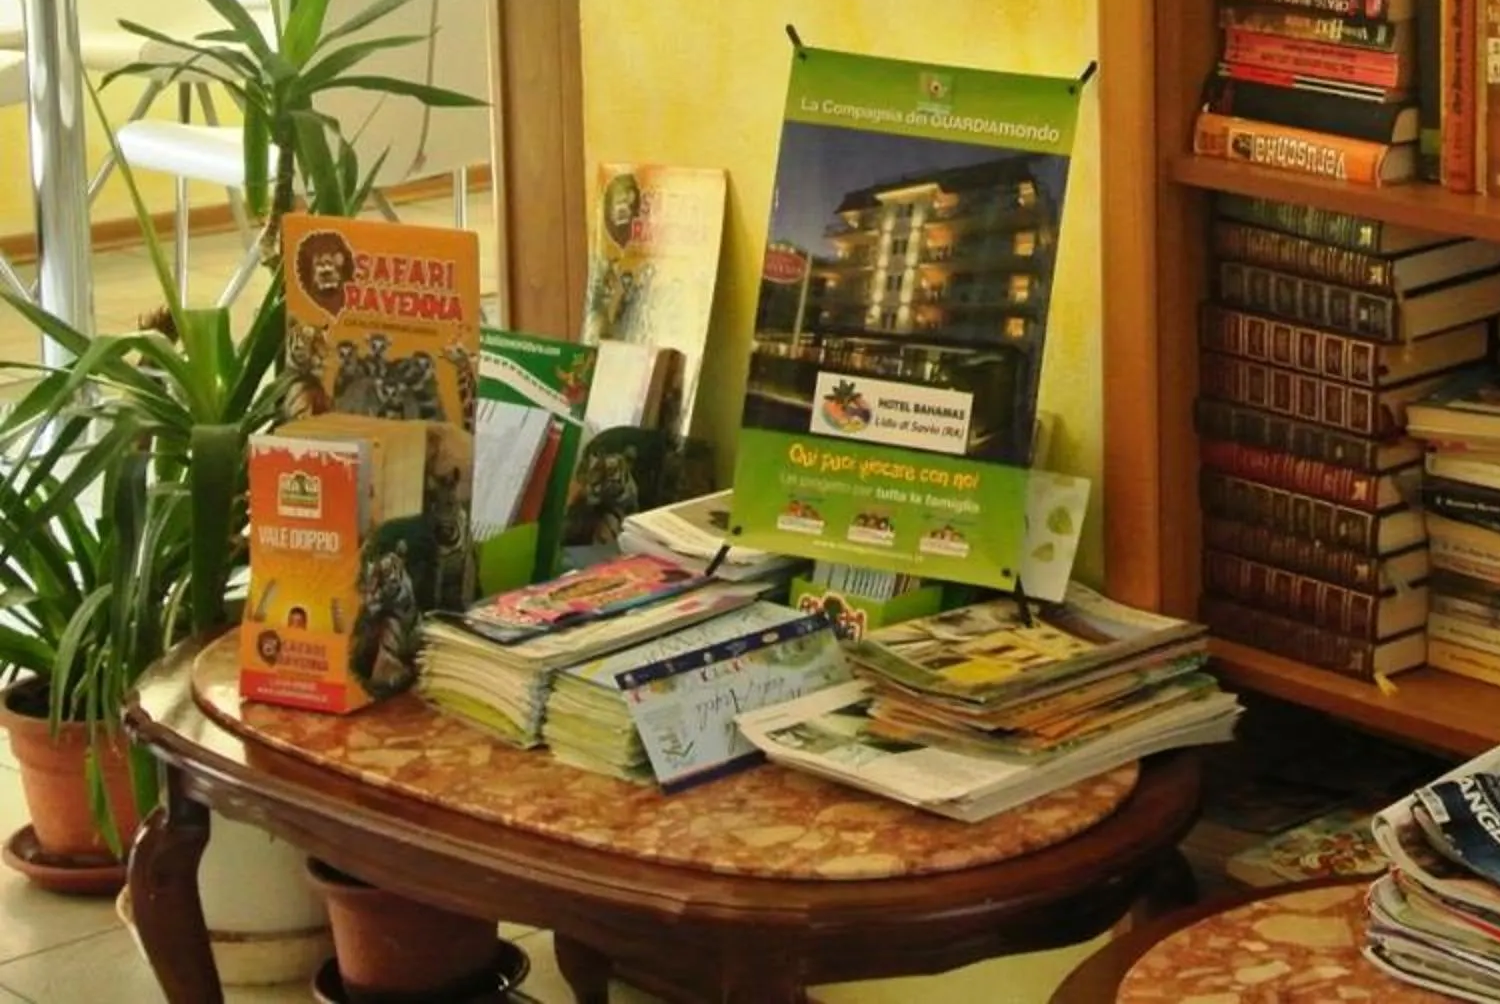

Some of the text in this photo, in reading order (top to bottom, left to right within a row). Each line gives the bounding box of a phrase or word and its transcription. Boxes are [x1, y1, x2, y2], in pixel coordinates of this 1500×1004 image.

[801, 97, 818, 111] La
[822, 99, 902, 124] Compagnia
[1253, 135, 1347, 181] Veruschka
[355, 251, 457, 290] SAFARI
[344, 283, 463, 322] RAVENNA
[878, 397, 966, 421] HOTEL BAHAMAS
[258, 525, 341, 554] VALE DOPPIO
